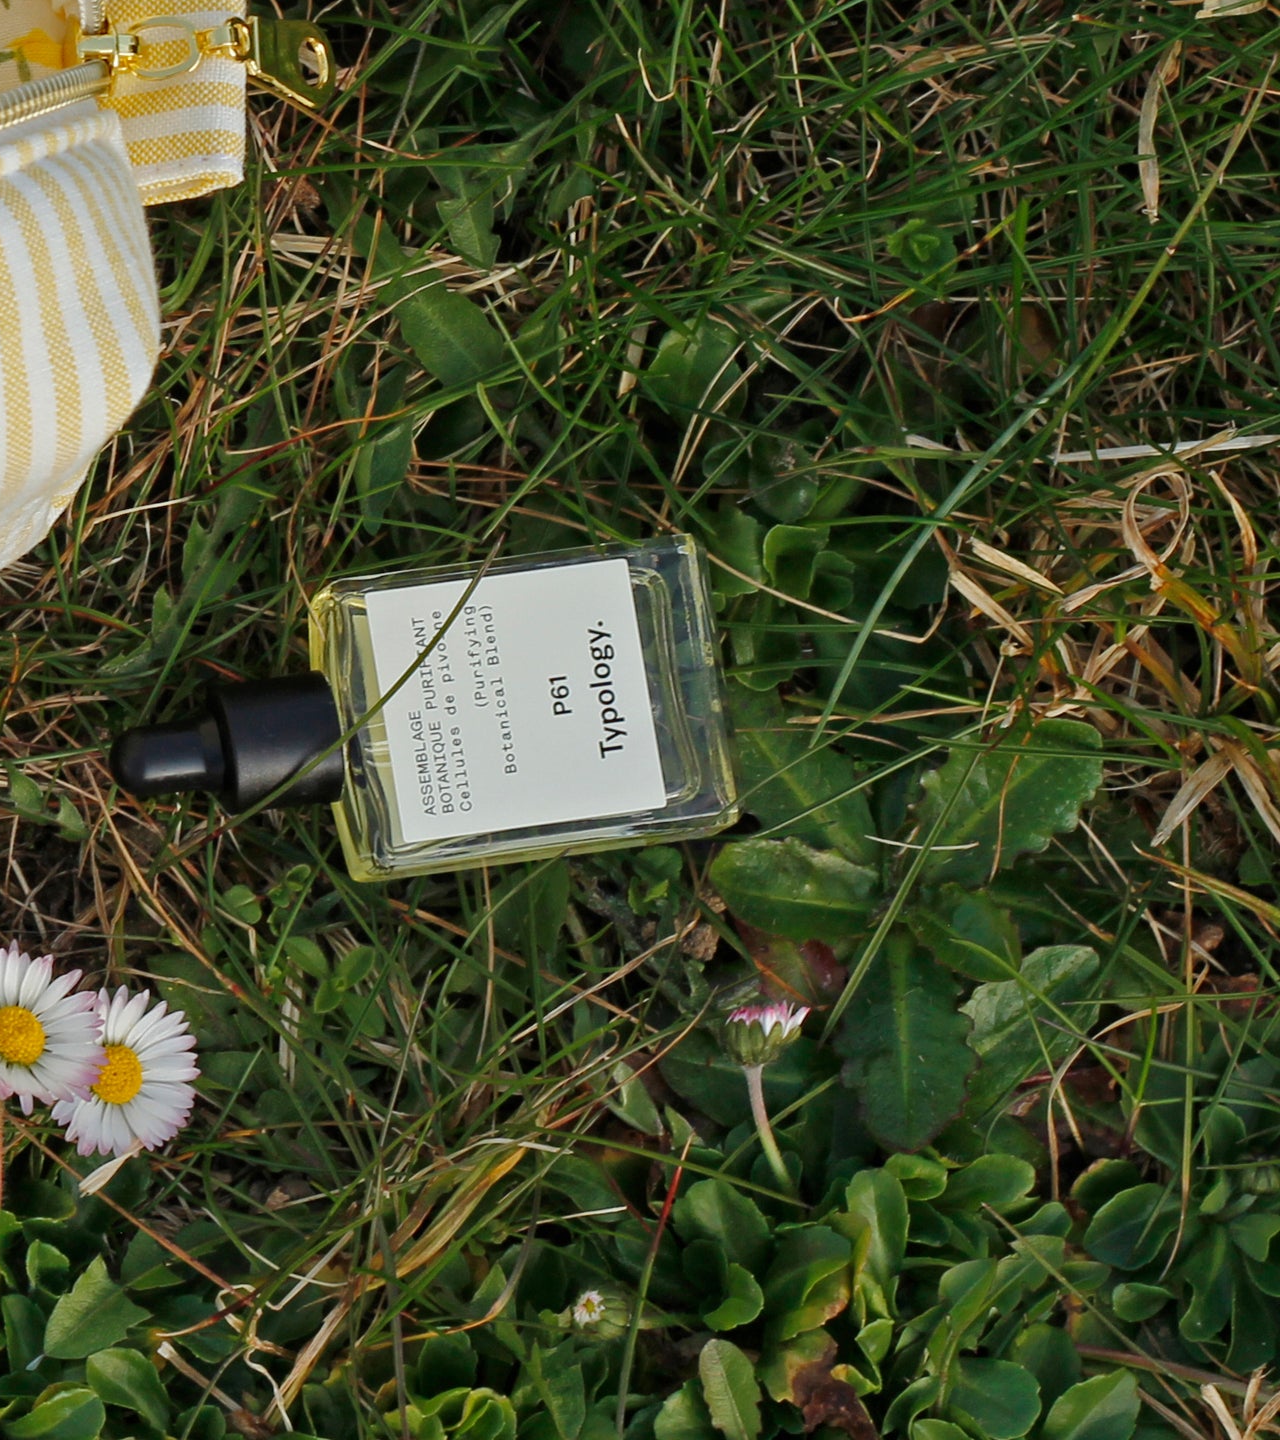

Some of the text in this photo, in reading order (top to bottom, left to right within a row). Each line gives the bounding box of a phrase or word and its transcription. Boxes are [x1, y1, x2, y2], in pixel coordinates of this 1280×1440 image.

[410, 617, 455, 814] BOTANIQUE PURIFANT
[430, 610, 474, 812] Cellules de pivone
[463, 605, 491, 709] (Purifying
[478, 605, 518, 775] Botanical Blend)
[549, 674, 573, 716] P61
[586, 619, 629, 759] Typology.
[410, 709, 438, 817] ASSEMBLAGE
